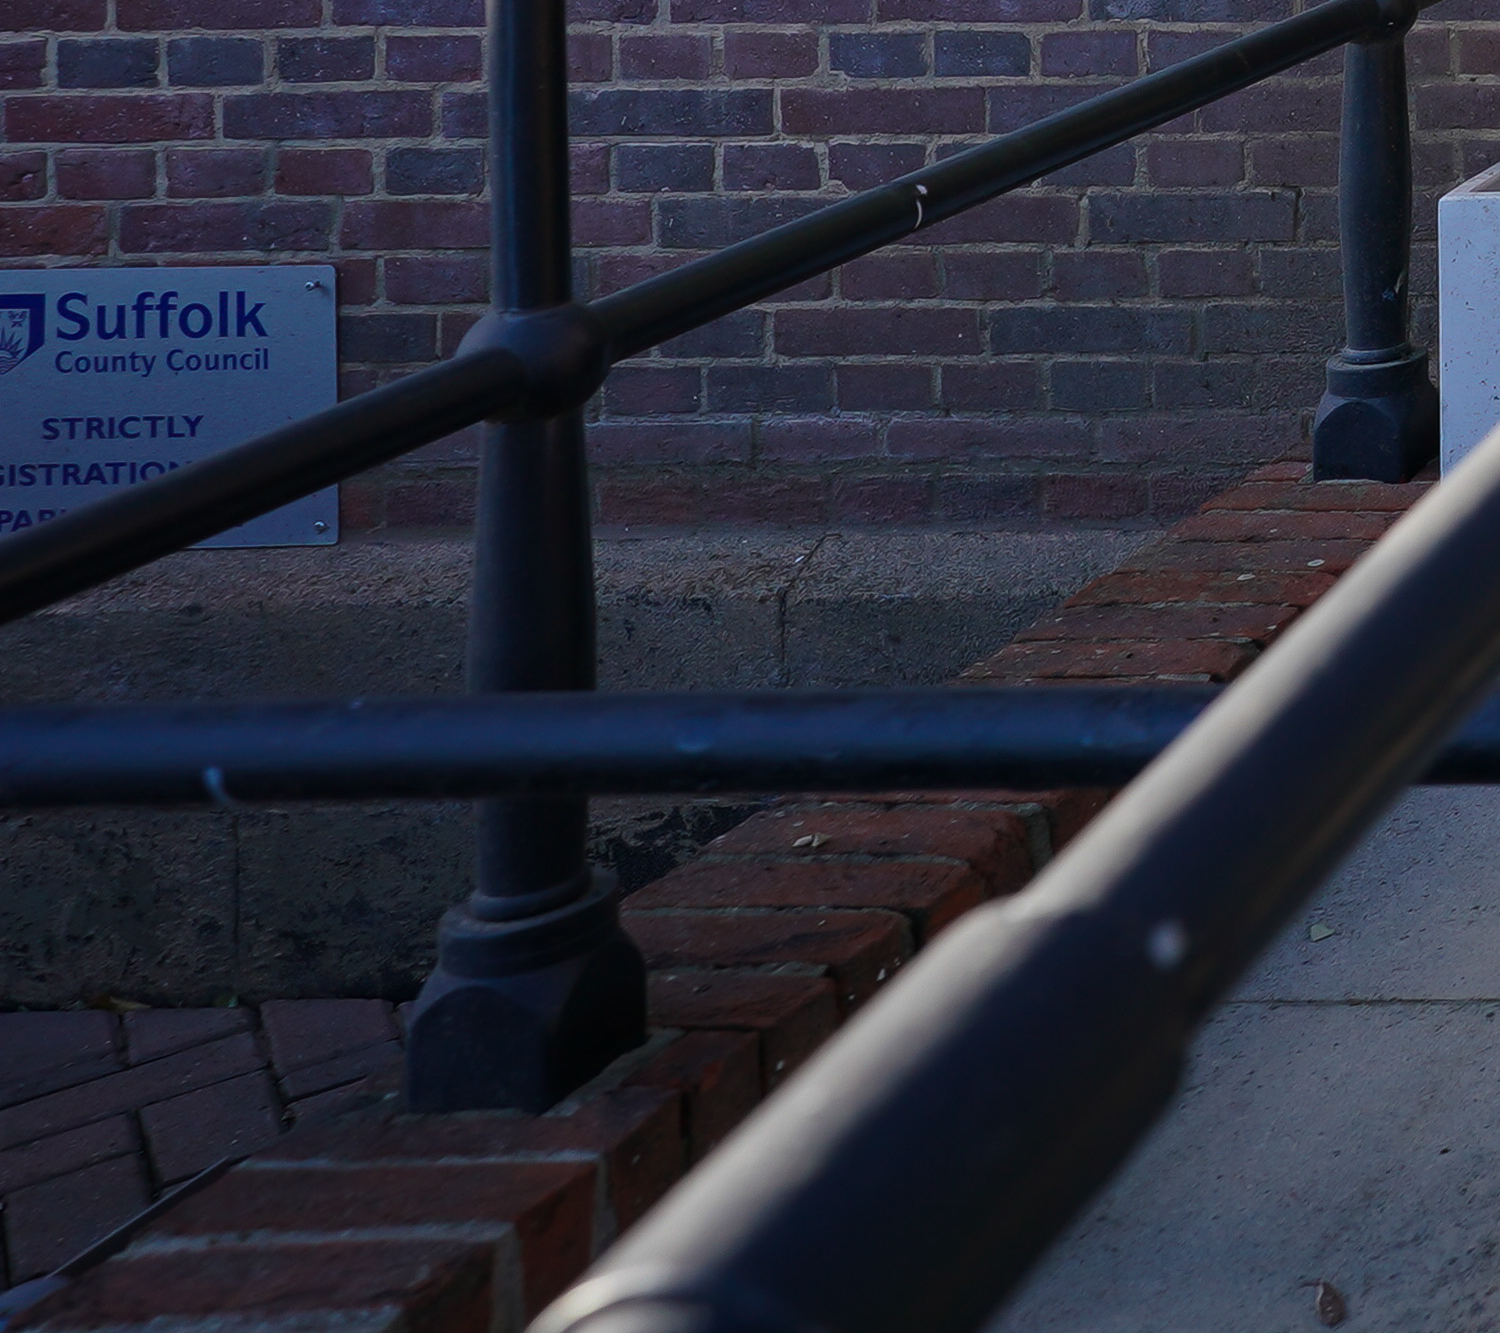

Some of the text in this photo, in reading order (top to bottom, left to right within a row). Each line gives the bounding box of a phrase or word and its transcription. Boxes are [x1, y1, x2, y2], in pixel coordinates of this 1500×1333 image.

[55, 290, 269, 342] Suffolk
[54, 348, 269, 377] County Council
[42, 414, 204, 441] STRICTLY
[0, 460, 192, 488] ISTRATIO
